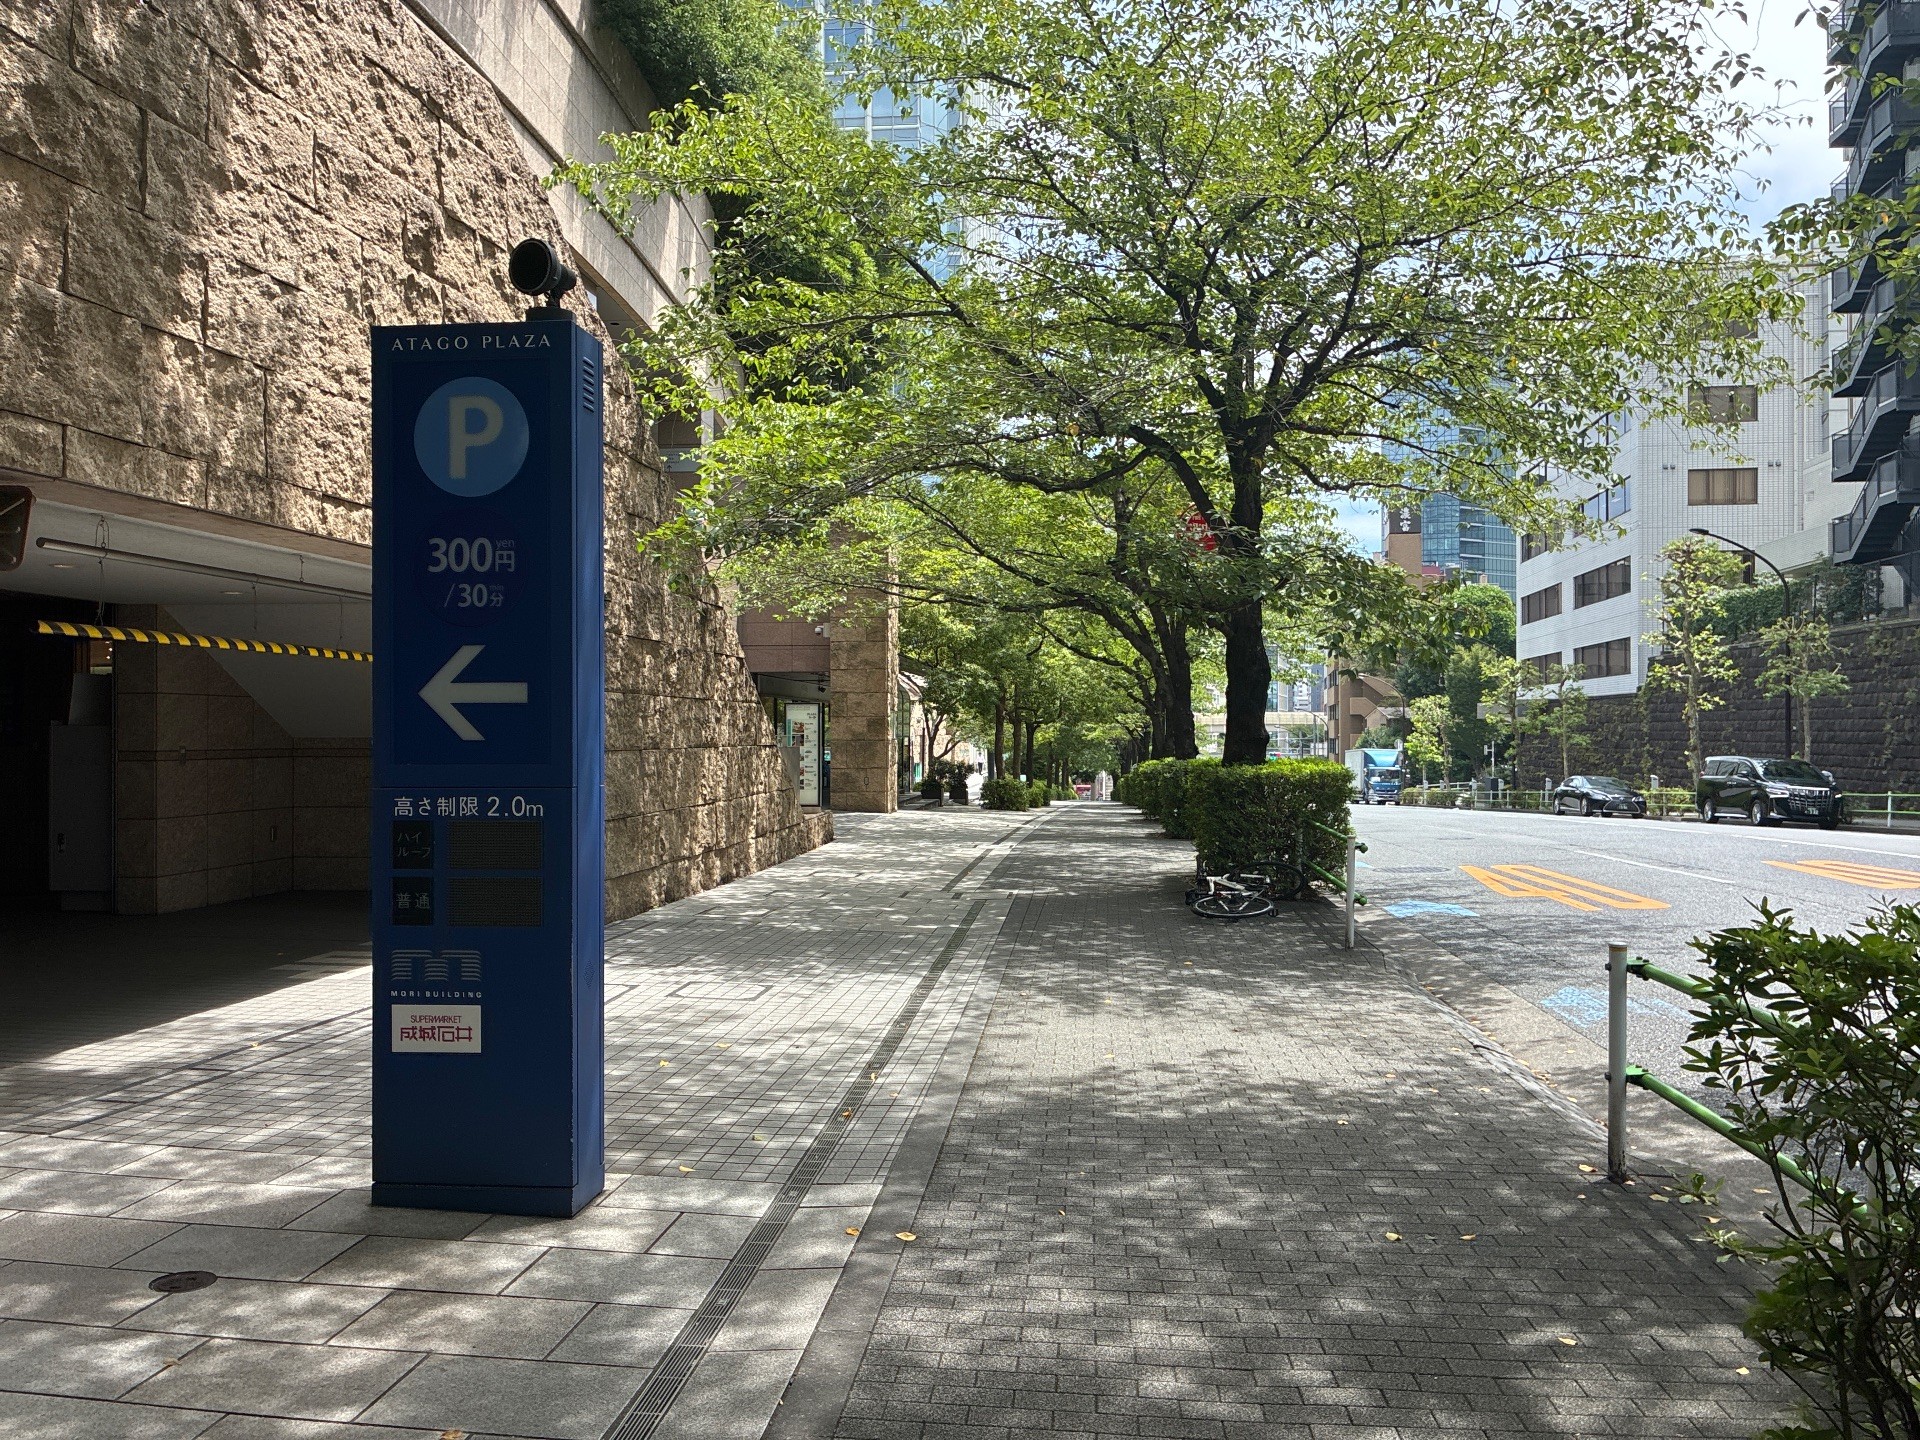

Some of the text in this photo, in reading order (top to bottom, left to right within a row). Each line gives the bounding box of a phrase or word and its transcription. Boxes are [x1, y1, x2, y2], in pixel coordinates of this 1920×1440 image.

[391, 334, 551, 352] ATAGO PLAZA
[448, 394, 504, 480] P
[394, 795, 544, 817] 高さ制限 2.0m
[396, 892, 431, 910] 普通
[390, 990, 482, 998] MORI BUILDING
[410, 1014, 462, 1024] SUPERMARKET
[400, 1025, 473, 1043] 成城石井
